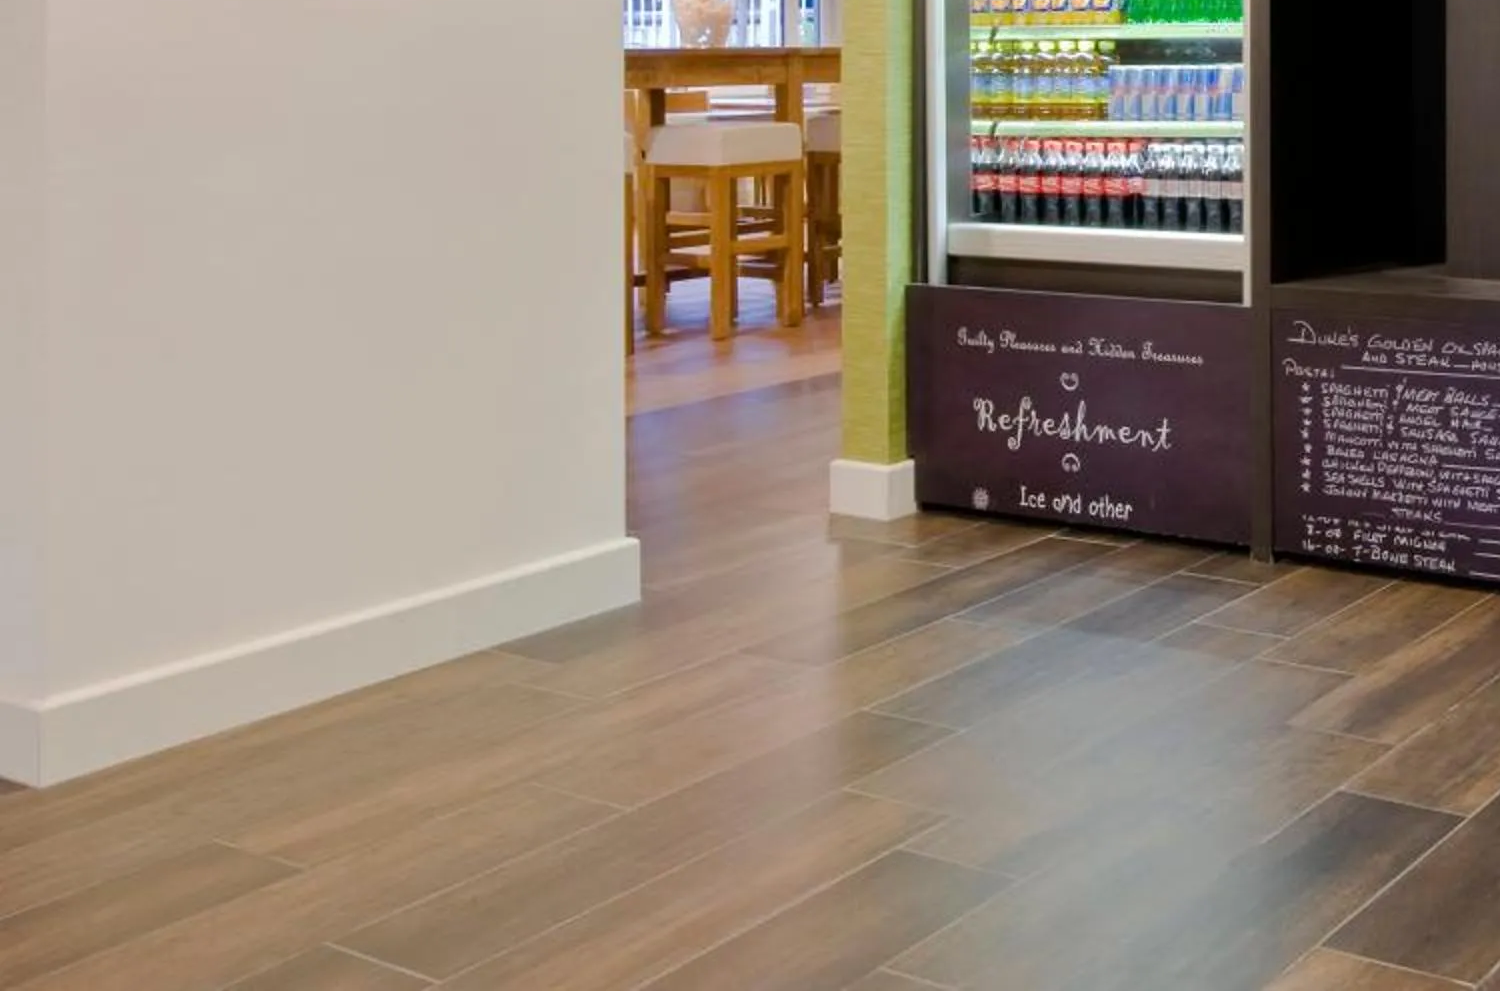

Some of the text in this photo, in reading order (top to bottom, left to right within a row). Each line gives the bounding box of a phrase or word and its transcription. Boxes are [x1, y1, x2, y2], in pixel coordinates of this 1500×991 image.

[958, 326, 1203, 365] Guilty Pleasures and Hidden Treasures
[973, 396, 1172, 452] Refreshment
[1019, 485, 1133, 521] Ice and other
